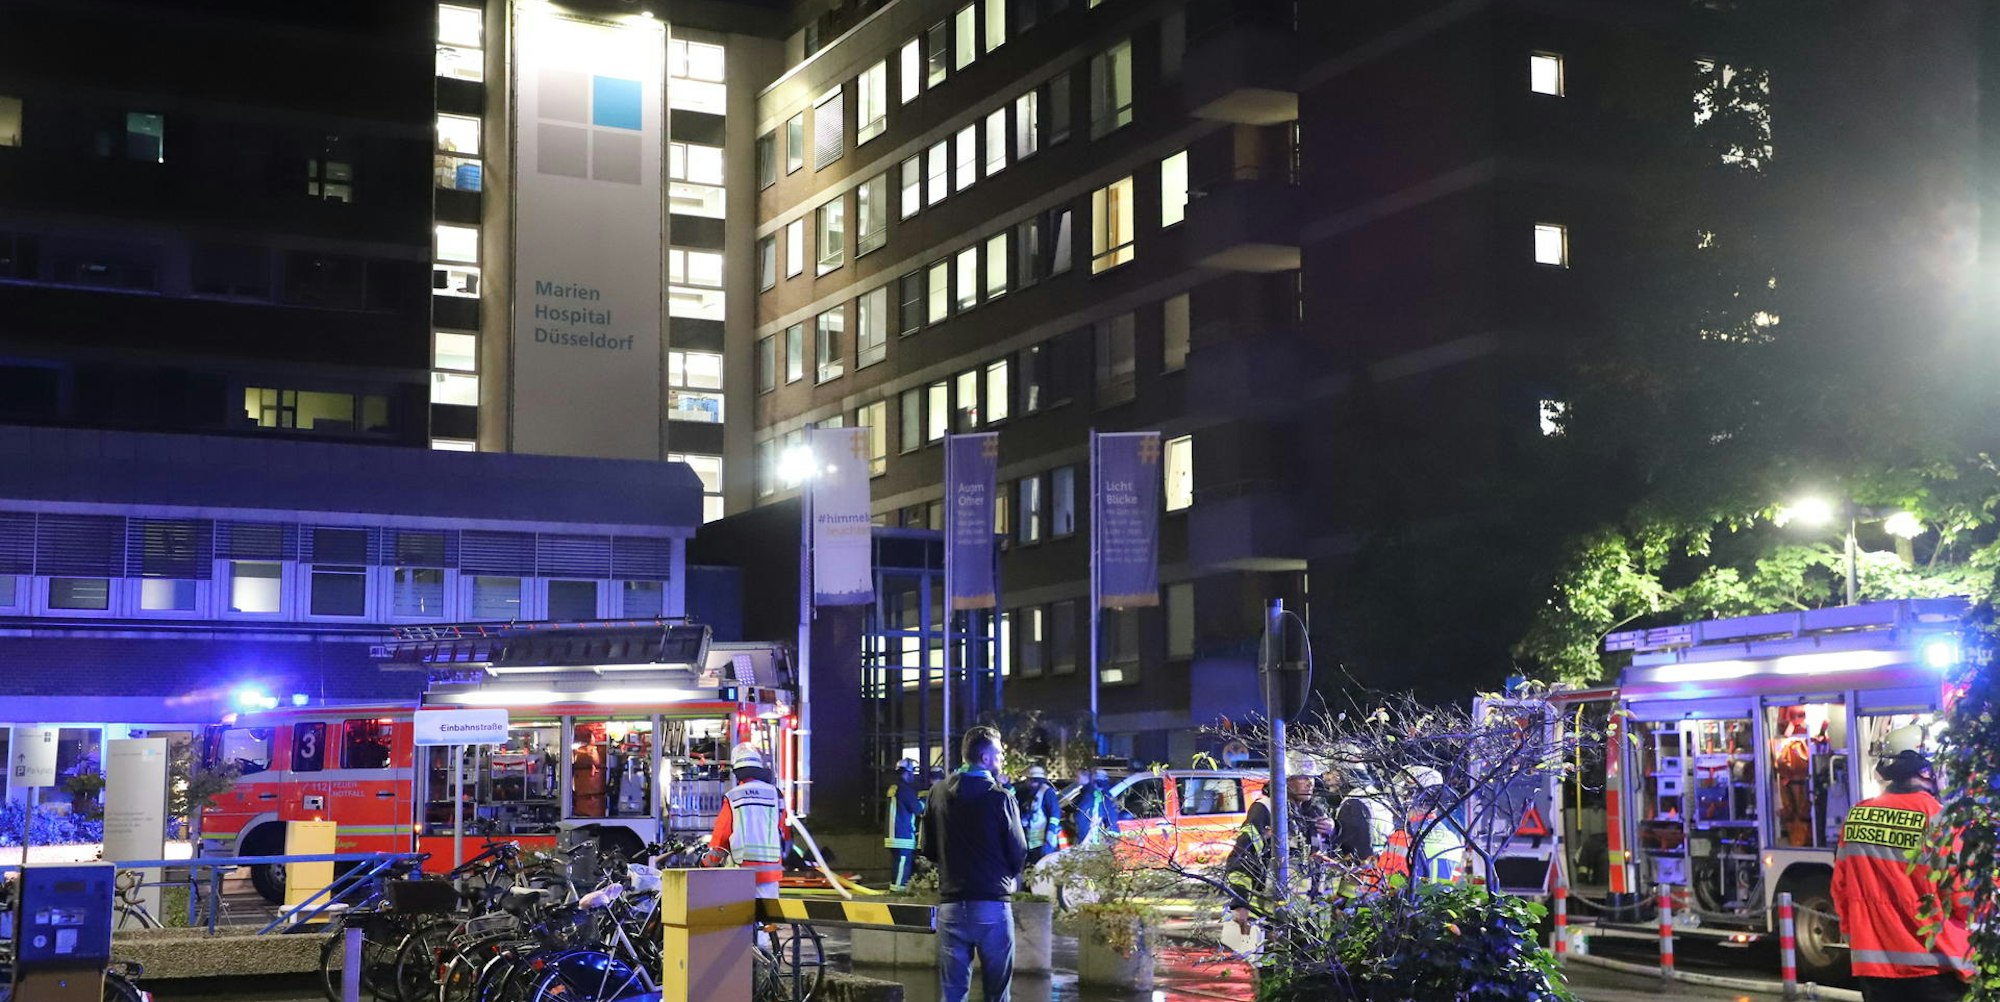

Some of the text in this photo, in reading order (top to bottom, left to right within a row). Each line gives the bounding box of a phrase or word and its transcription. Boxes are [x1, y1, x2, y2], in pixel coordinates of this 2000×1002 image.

[535, 280, 600, 301] Marien
[535, 304, 611, 326] Hospital
[535, 327, 634, 350] Düsseldorf
[1106, 481, 1133, 492] Licht
[1106, 493, 1138, 505] Blicke
[441, 723, 503, 732] Einbahnstraße
[301, 733, 316, 758] 3
[312, 783, 327, 792] 112
[1847, 807, 1925, 828] FEUERWEHR
[1845, 824, 1920, 848] DÜSSELDORF
